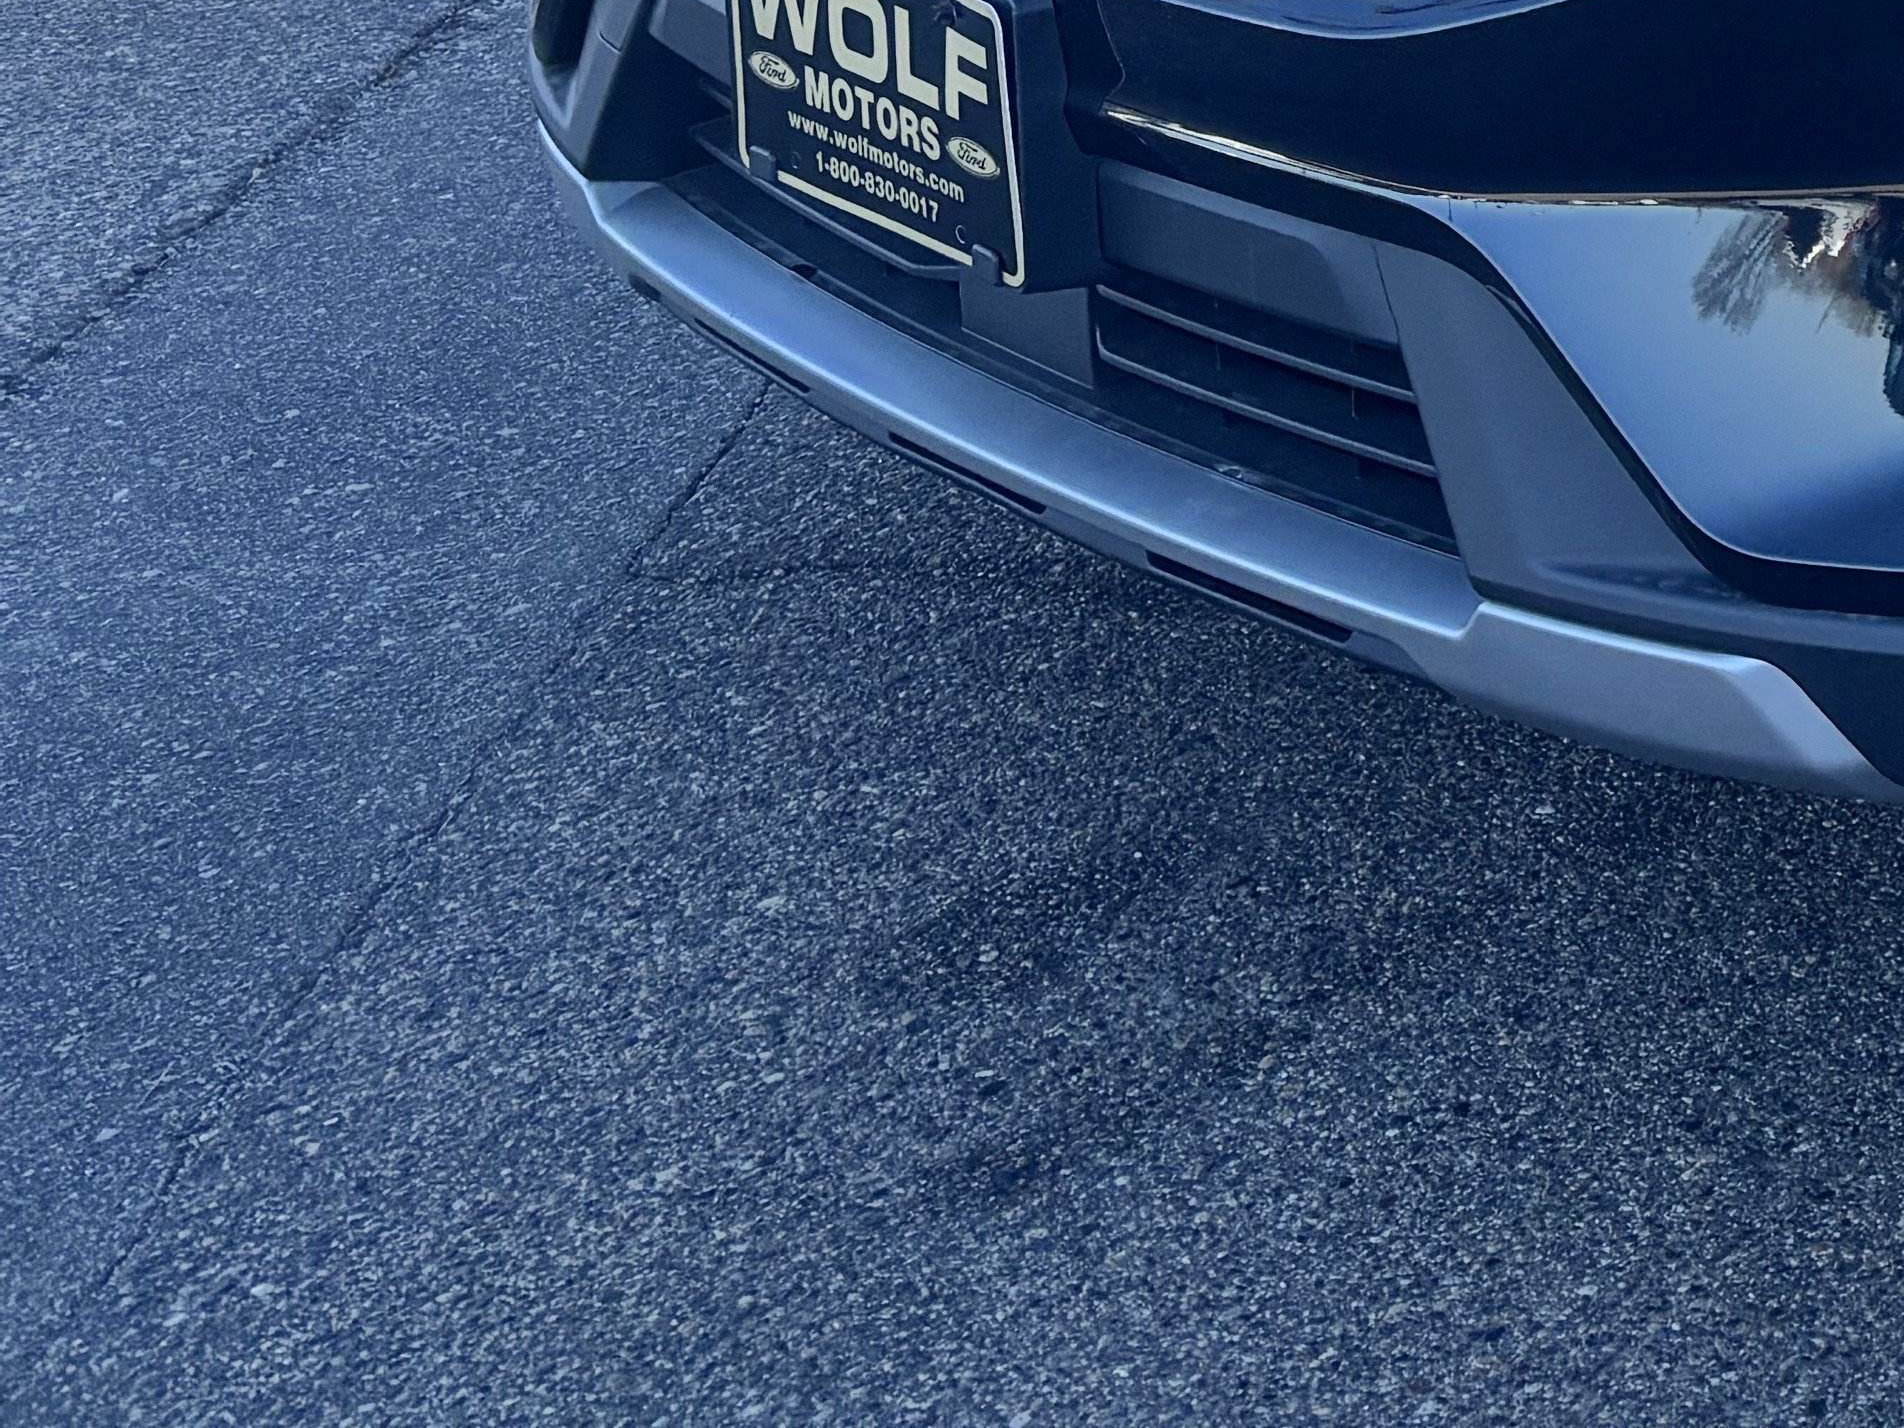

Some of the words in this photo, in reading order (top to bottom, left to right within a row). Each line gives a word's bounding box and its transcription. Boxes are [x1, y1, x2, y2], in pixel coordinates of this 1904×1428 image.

[787, 110, 966, 204] www.wolfmotors.com
[803, 64, 941, 161] MOTORS
[815, 150, 940, 223] 1-800-830-0017
